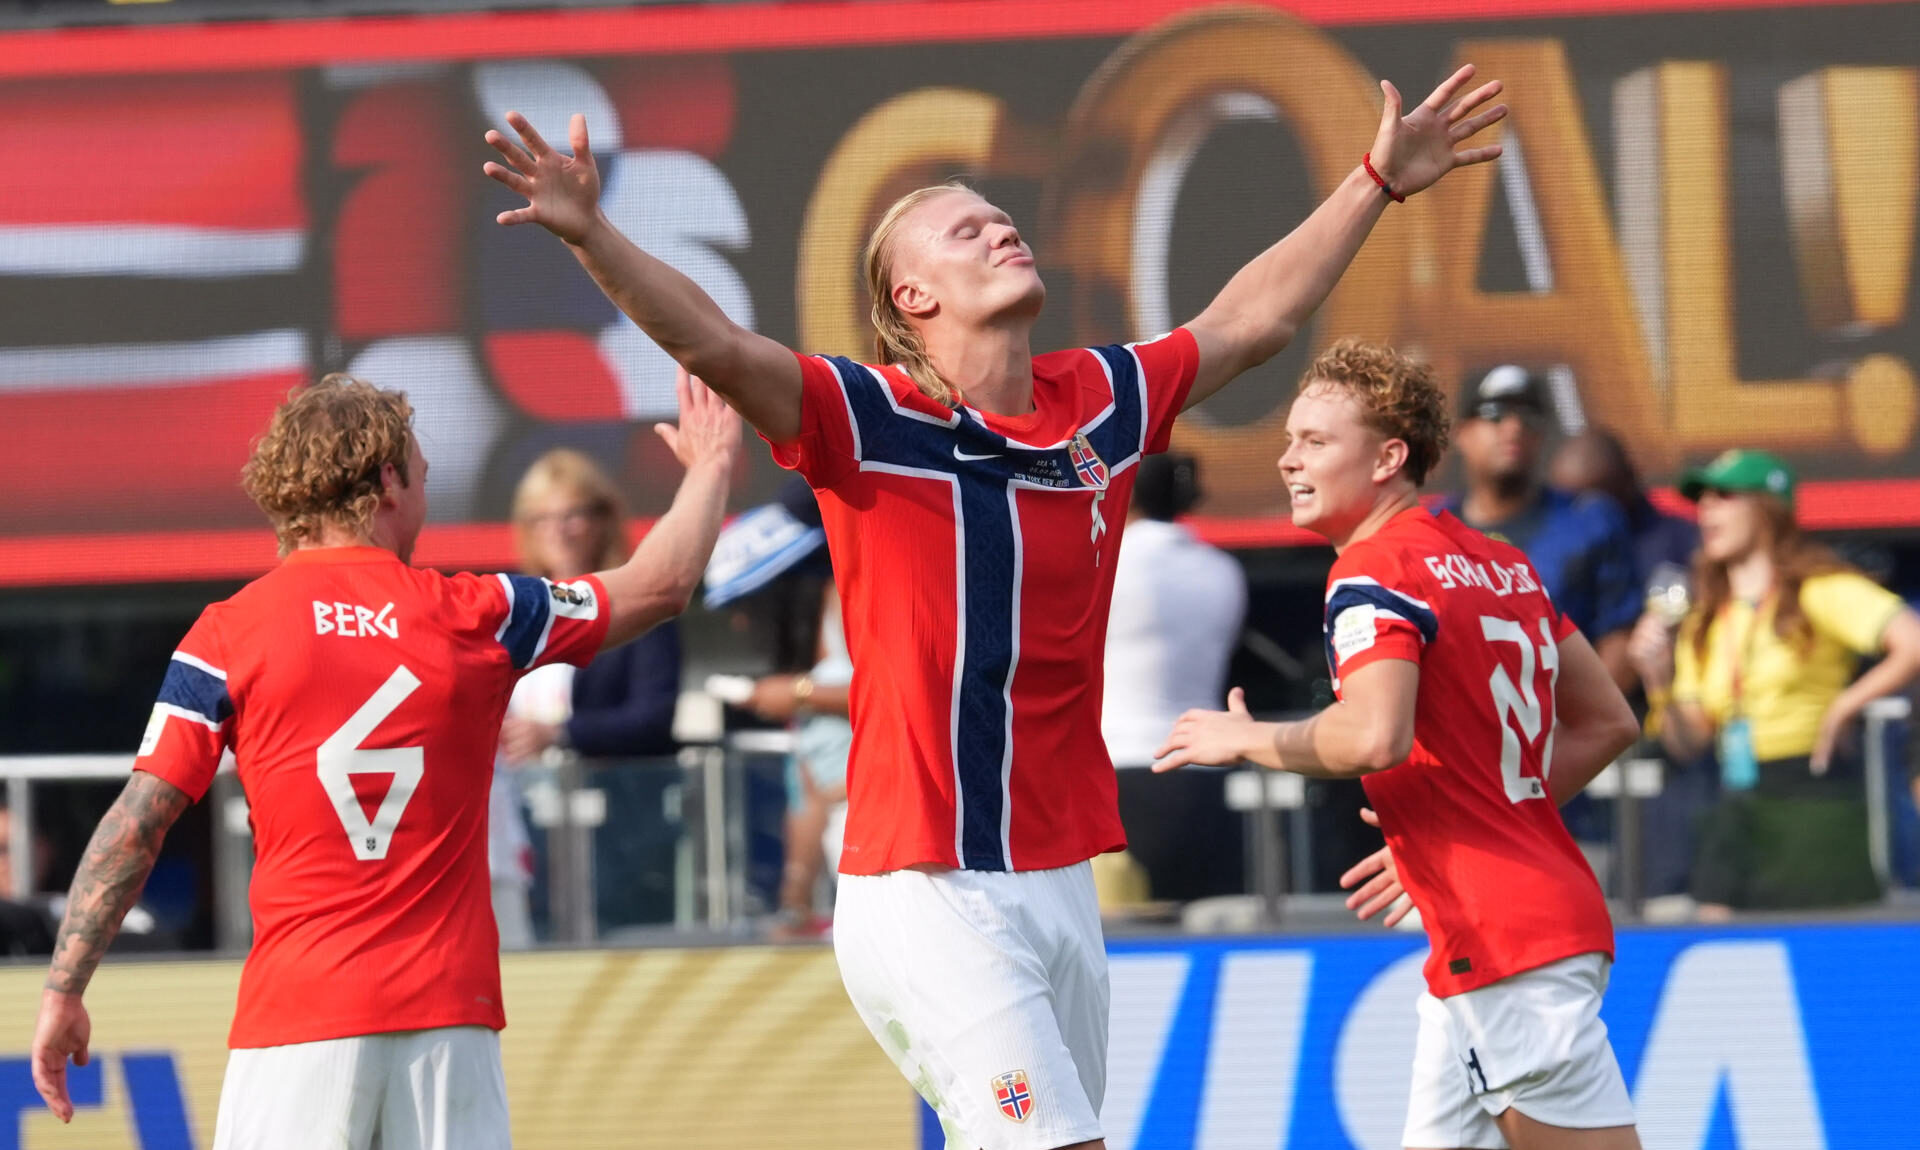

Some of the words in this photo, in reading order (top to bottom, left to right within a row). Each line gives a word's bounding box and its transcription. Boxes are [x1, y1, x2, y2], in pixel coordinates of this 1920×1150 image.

[312, 600, 399, 639] BERG
[1479, 615, 1559, 804] 21
[316, 664, 424, 860] 6
